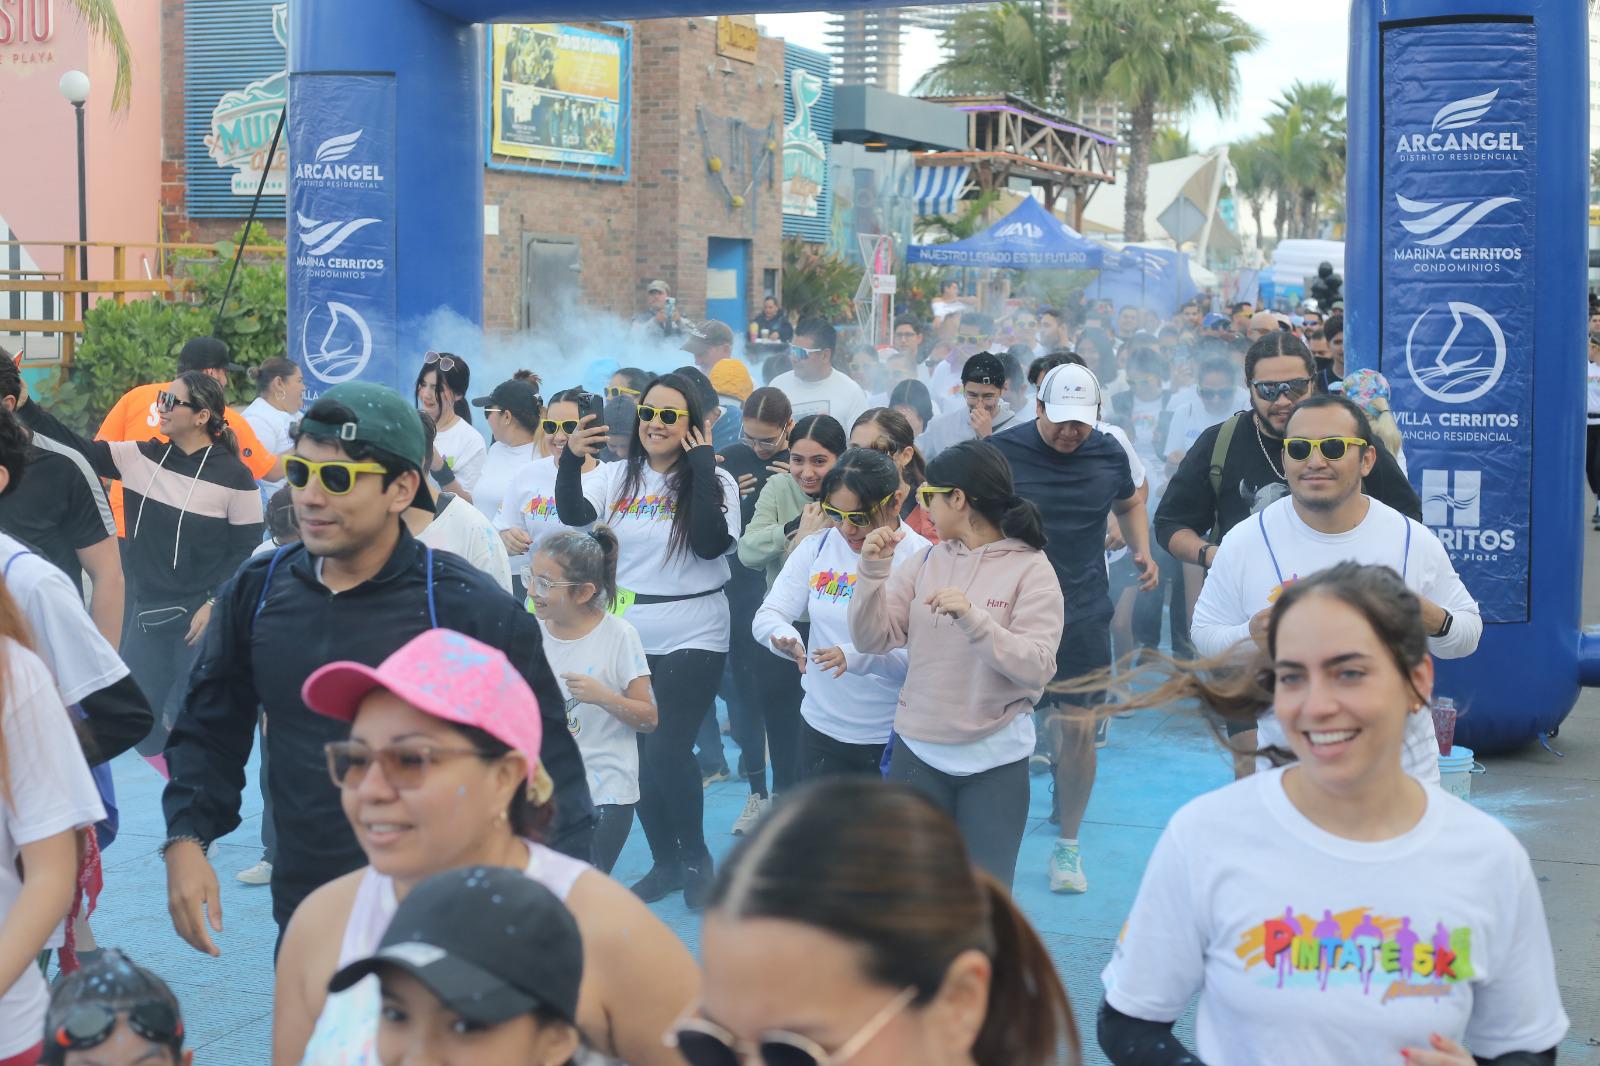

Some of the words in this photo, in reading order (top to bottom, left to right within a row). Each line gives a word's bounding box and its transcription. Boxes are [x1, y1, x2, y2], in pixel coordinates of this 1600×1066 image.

[1396, 132, 1524, 153] ARCANGEL
[1400, 153, 1445, 162] DISTRITO
[1449, 152, 1519, 161] RESIDENCIAL
[295, 163, 384, 181] ARCANGEL
[326, 180, 379, 189] RESIDENCIAL
[919, 248, 967, 263] NUESTRO
[969, 249, 1011, 264] LEGADO
[1012, 251, 1027, 265] ES
[1028, 251, 1043, 265] TU
[1044, 251, 1087, 264] FUTURO
[1394, 247, 1446, 261] MARINA
[1449, 246, 1522, 261] CERRITOS
[296, 256, 326, 268] MARINA
[327, 258, 384, 270] CERRITOS
[1413, 262, 1501, 273] CONDOMINIOS
[306, 269, 366, 280] CONDOMINIOS
[301, 389, 320, 401] ILLA
[1438, 412, 1519, 428] CERRITOS
[1443, 431, 1512, 442] RESIDENCIAL
[1430, 528, 1516, 551] RITOS
[1463, 552, 1498, 561] Plaza
[1263, 918, 1403, 975] PINTATE
